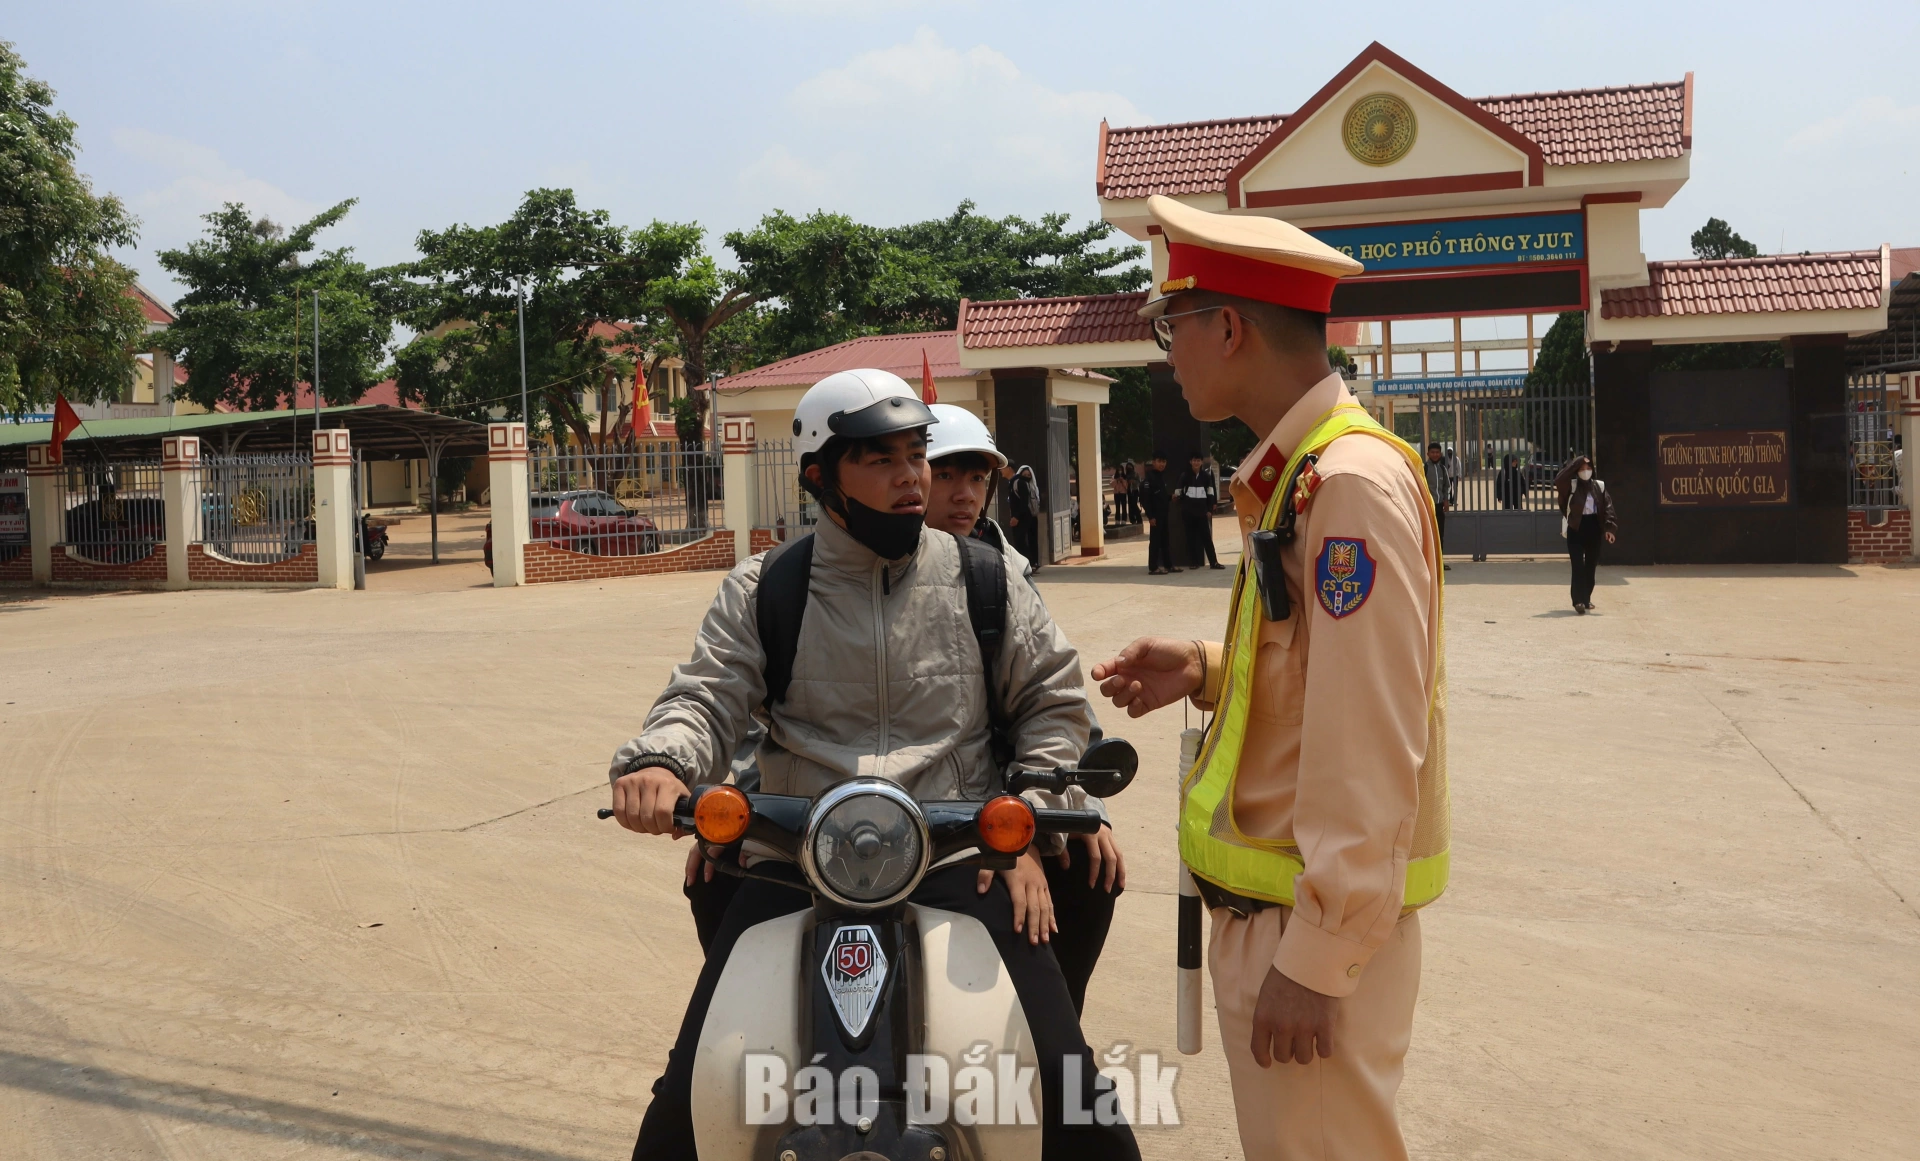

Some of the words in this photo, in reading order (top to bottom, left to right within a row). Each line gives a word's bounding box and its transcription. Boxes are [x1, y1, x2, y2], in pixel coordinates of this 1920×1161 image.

[1360, 243, 1397, 261] HỌC
[1402, 231, 1441, 257] PHỔ
[1445, 233, 1515, 254] THÔNG
[1518, 234, 1531, 250] Y
[1533, 232, 1574, 249] JUT
[1663, 442, 1693, 465] TRƯỜNG
[1694, 446, 1720, 465] TRUNG
[1721, 446, 1737, 468] HỌC
[1738, 436, 1754, 464] PHỔ
[1755, 440, 1782, 463] THÔNG
[1671, 468, 1713, 495] CHUẨN
[1716, 468, 1750, 499] QUỐC
[1753, 476, 1776, 494] GIA
[840, 946, 868, 969] 50
